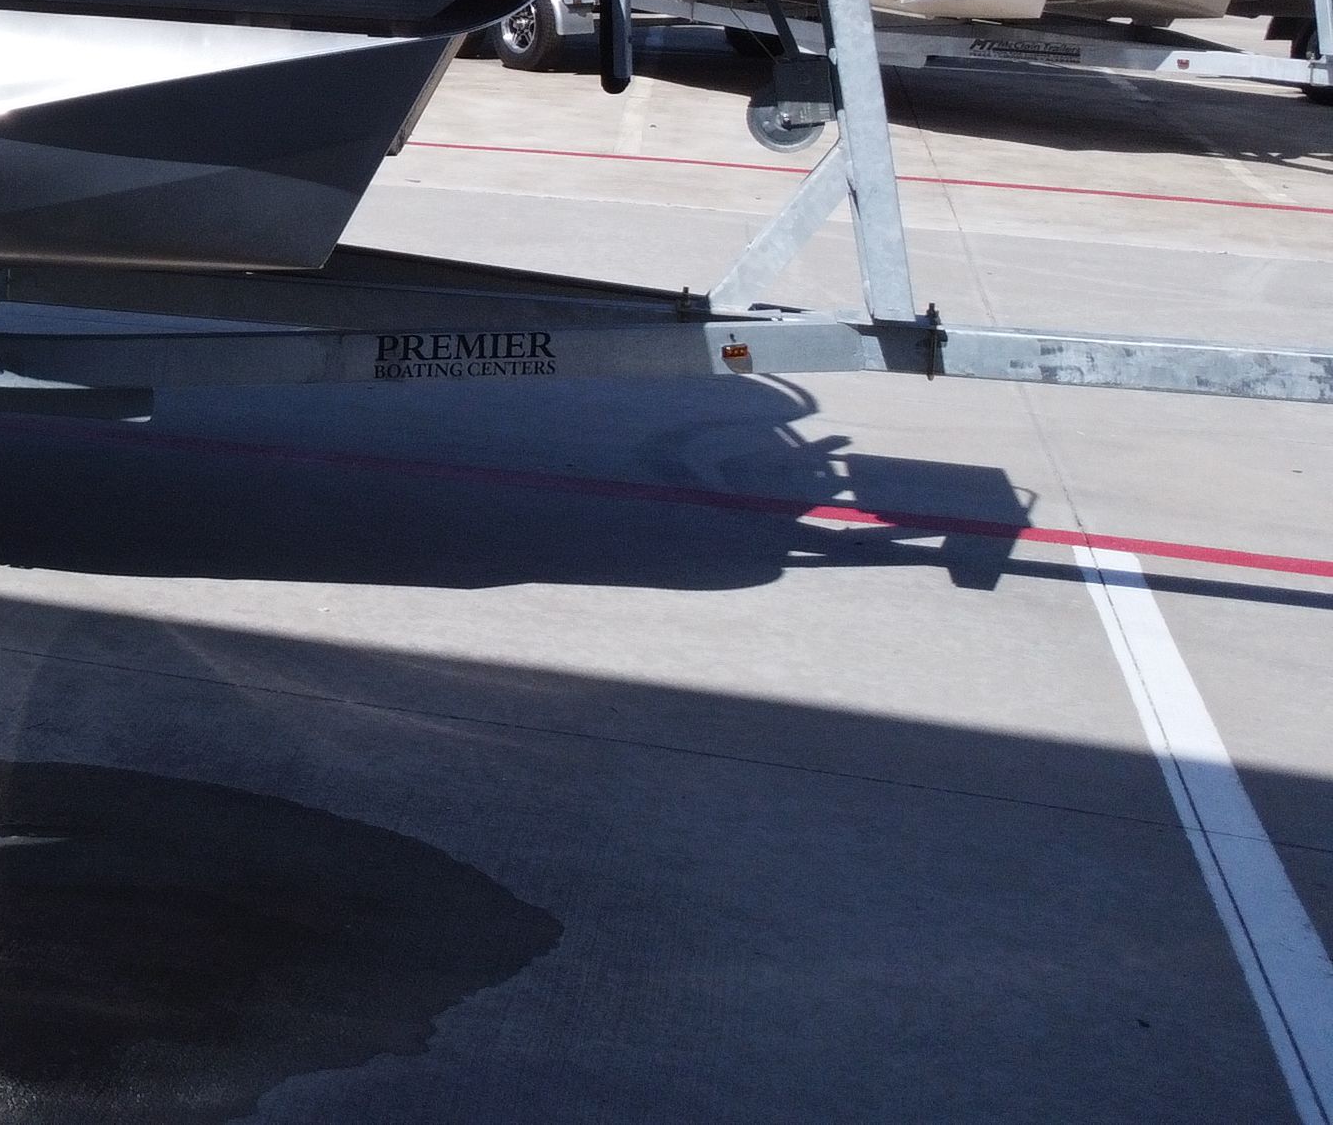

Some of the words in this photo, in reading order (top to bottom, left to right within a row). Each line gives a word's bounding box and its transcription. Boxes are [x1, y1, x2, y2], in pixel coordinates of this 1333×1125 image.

[375, 331, 557, 362] PREMIER
[374, 362, 463, 379] BOATING
[467, 360, 556, 377] CENTERS
